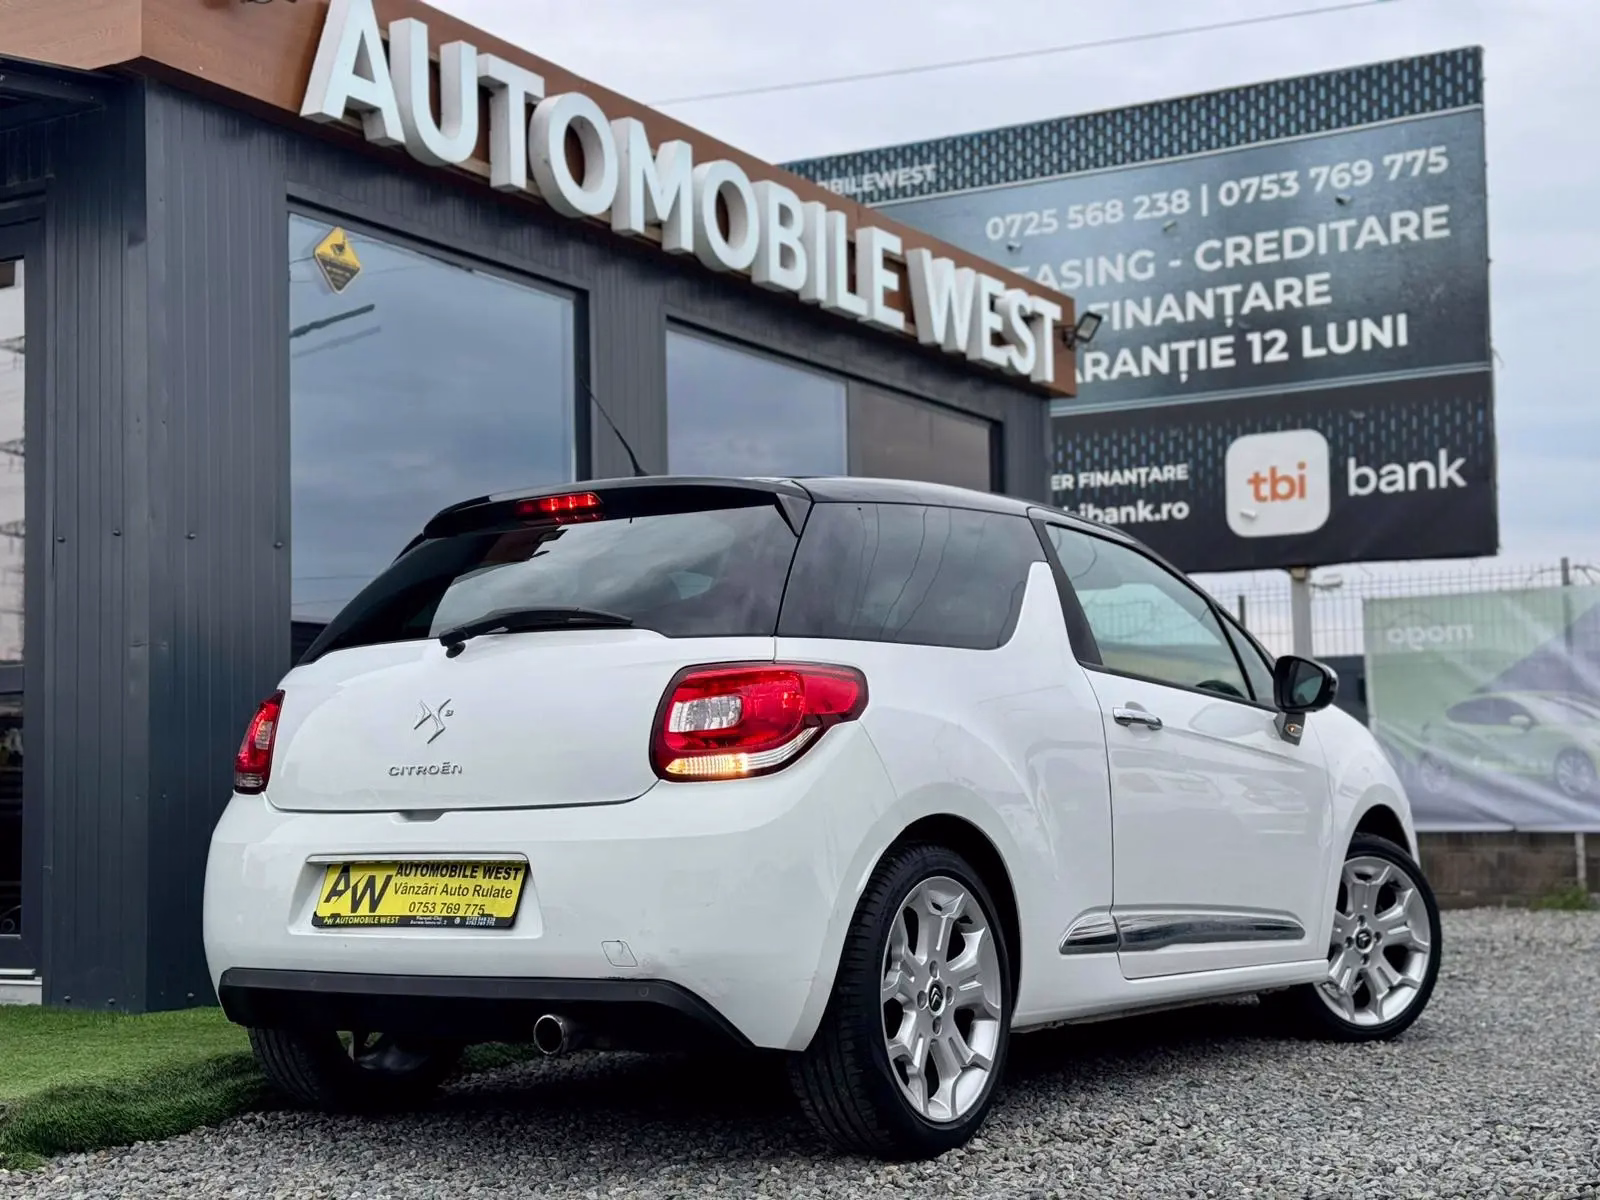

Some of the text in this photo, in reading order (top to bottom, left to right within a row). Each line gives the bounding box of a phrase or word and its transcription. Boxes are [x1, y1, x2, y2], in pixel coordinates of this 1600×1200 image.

[300, 0, 1062, 383] AUTOMOBILE WEST
[985, 208, 1058, 240] 0725
[1067, 199, 1124, 229] 568
[1133, 189, 1191, 220] 238
[1218, 170, 1300, 206] 0753
[1309, 159, 1373, 193] 769
[1382, 145, 1449, 181] 775
[1010, 249, 1155, 290] ASING
[1194, 204, 1450, 272] CREDITARE
[1075, 312, 1408, 385] RANȚIE 12 LUNI
[1247, 461, 1307, 504] tbi
[1347, 447, 1467, 497] bank
[1063, 500, 1190, 525] ibank.ro
[388, 761, 463, 777] CITROËN
[395, 862, 522, 881] AUTOMOBILE WEST
[440, 883, 470, 898] Auto
[472, 884, 513, 899] Rulate
[335, 916, 379, 924] AUTOMOBILE
[380, 916, 400, 924] WEST
[408, 901, 486, 916] 0753 769 775
